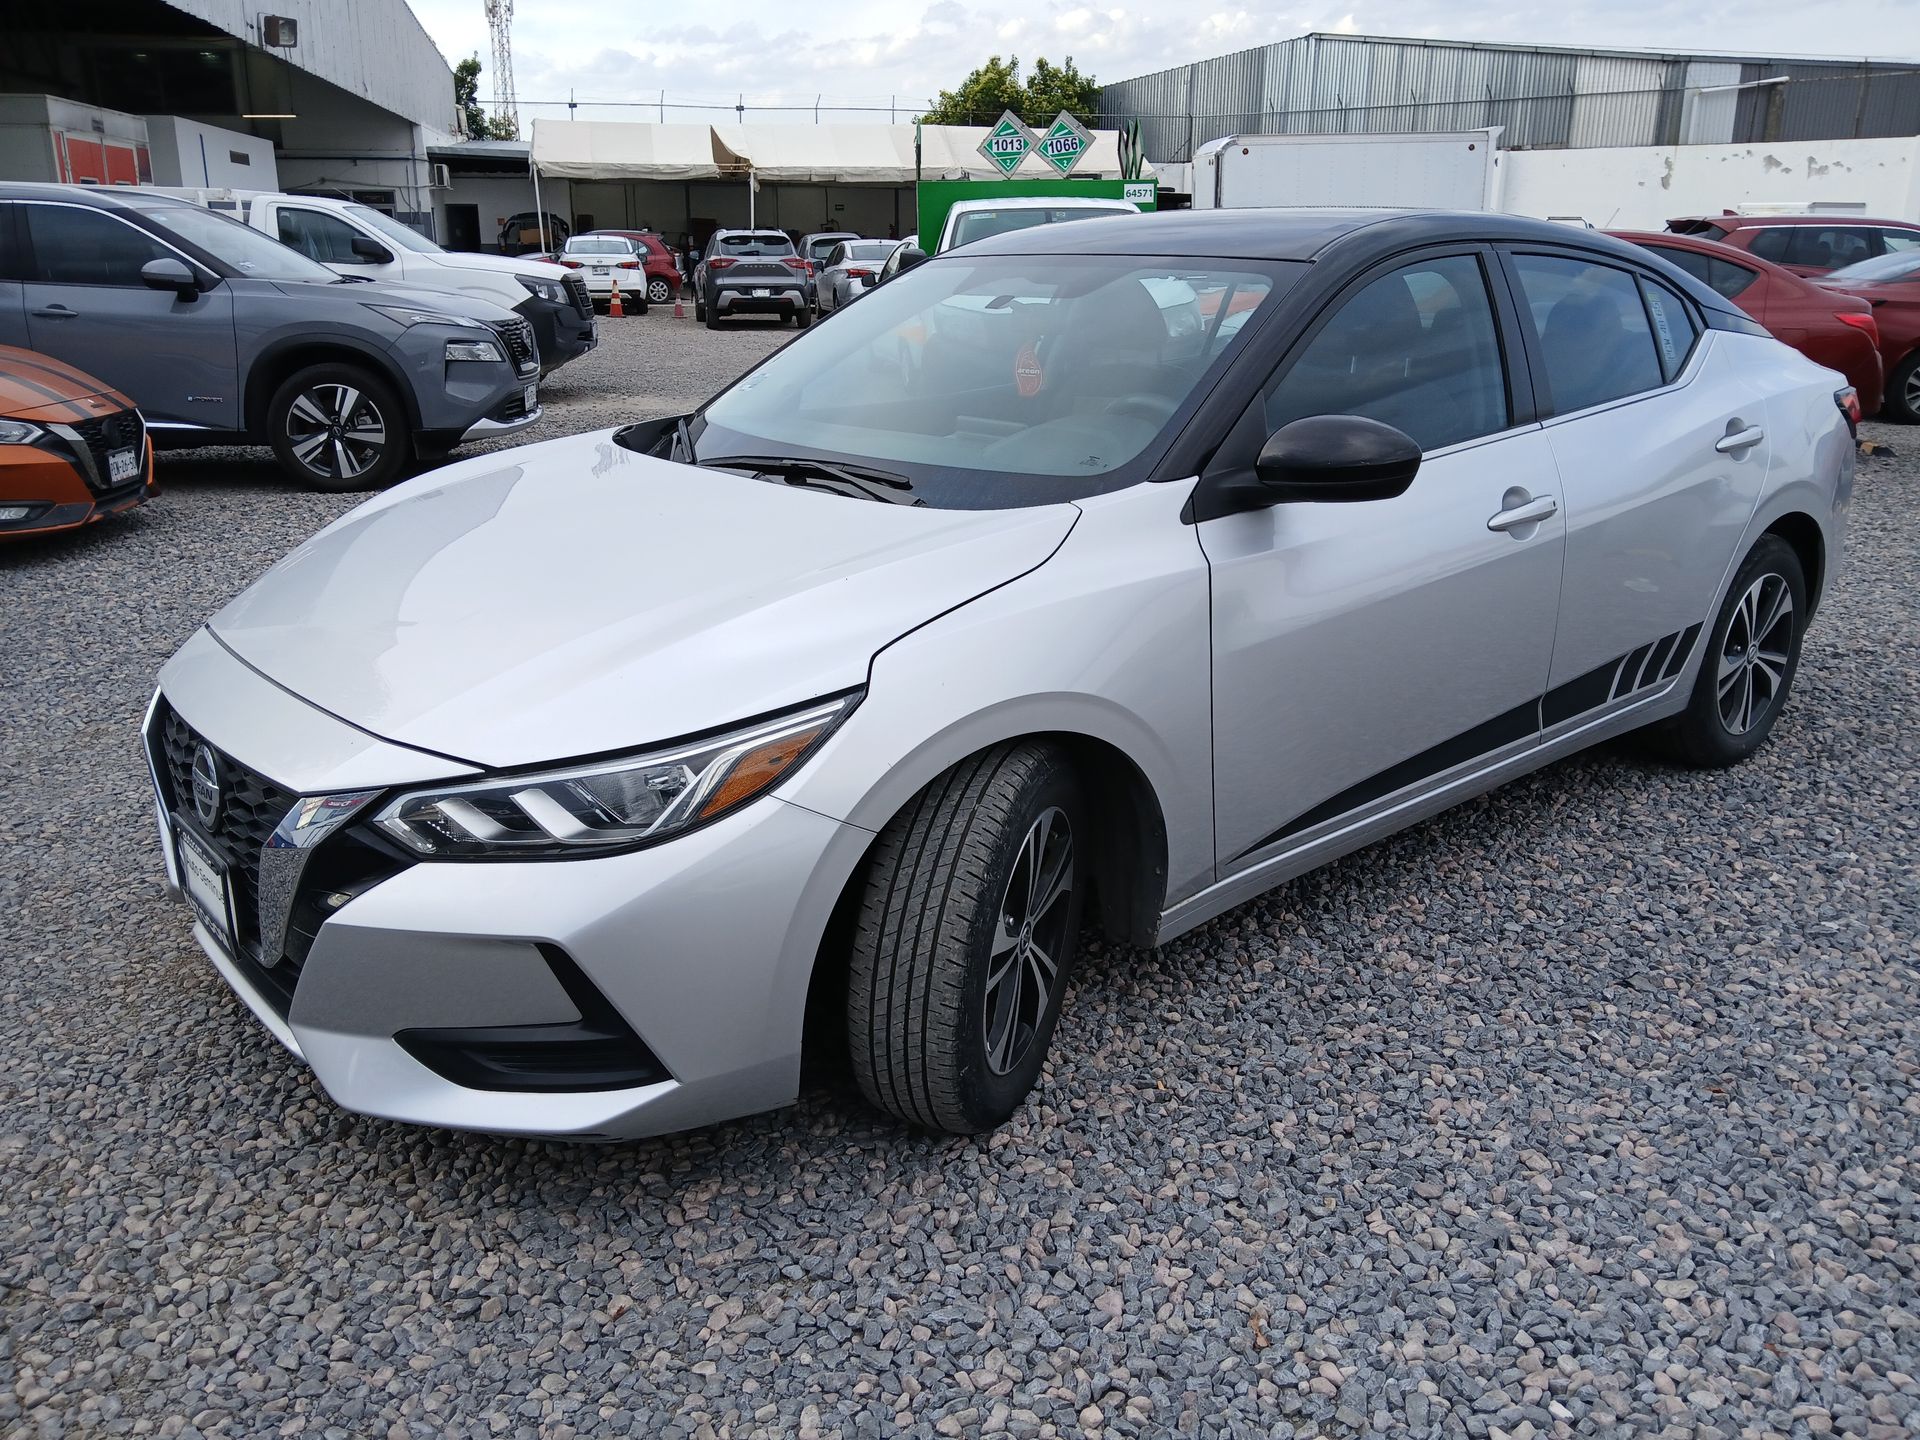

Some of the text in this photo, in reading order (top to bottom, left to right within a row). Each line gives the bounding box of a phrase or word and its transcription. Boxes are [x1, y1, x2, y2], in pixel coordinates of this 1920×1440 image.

[994, 138, 1023, 151] 1013
[1048, 137, 1078, 154] 1066
[1125, 189, 1153, 198] 64571
